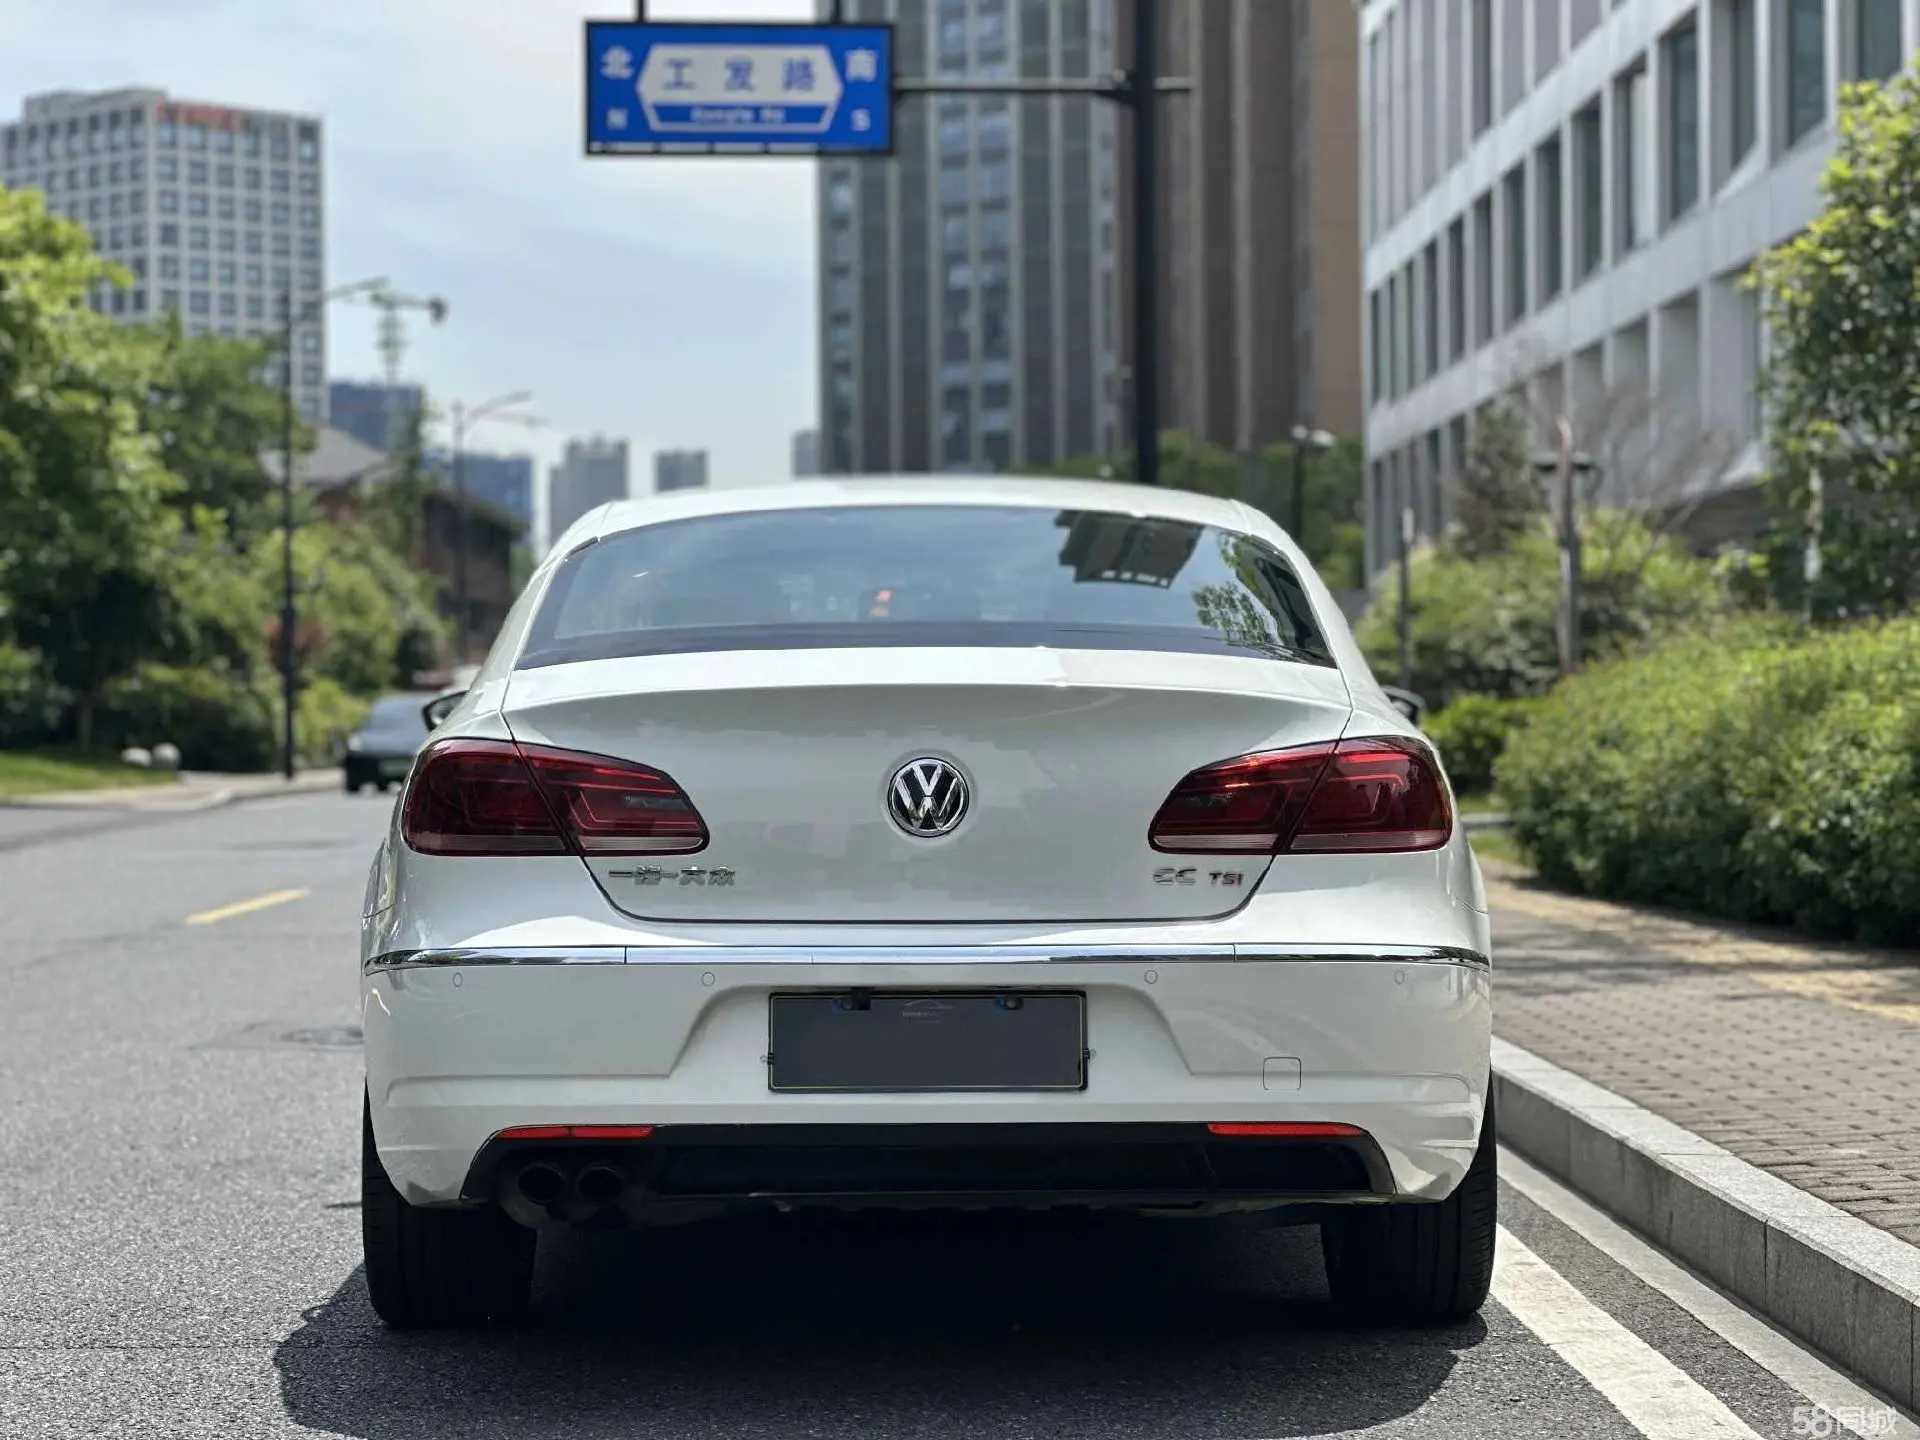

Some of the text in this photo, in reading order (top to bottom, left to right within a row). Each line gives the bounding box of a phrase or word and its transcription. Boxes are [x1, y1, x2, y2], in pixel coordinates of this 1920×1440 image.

[663, 57, 816, 91] 工发路
[1208, 871, 1244, 887] TSI
